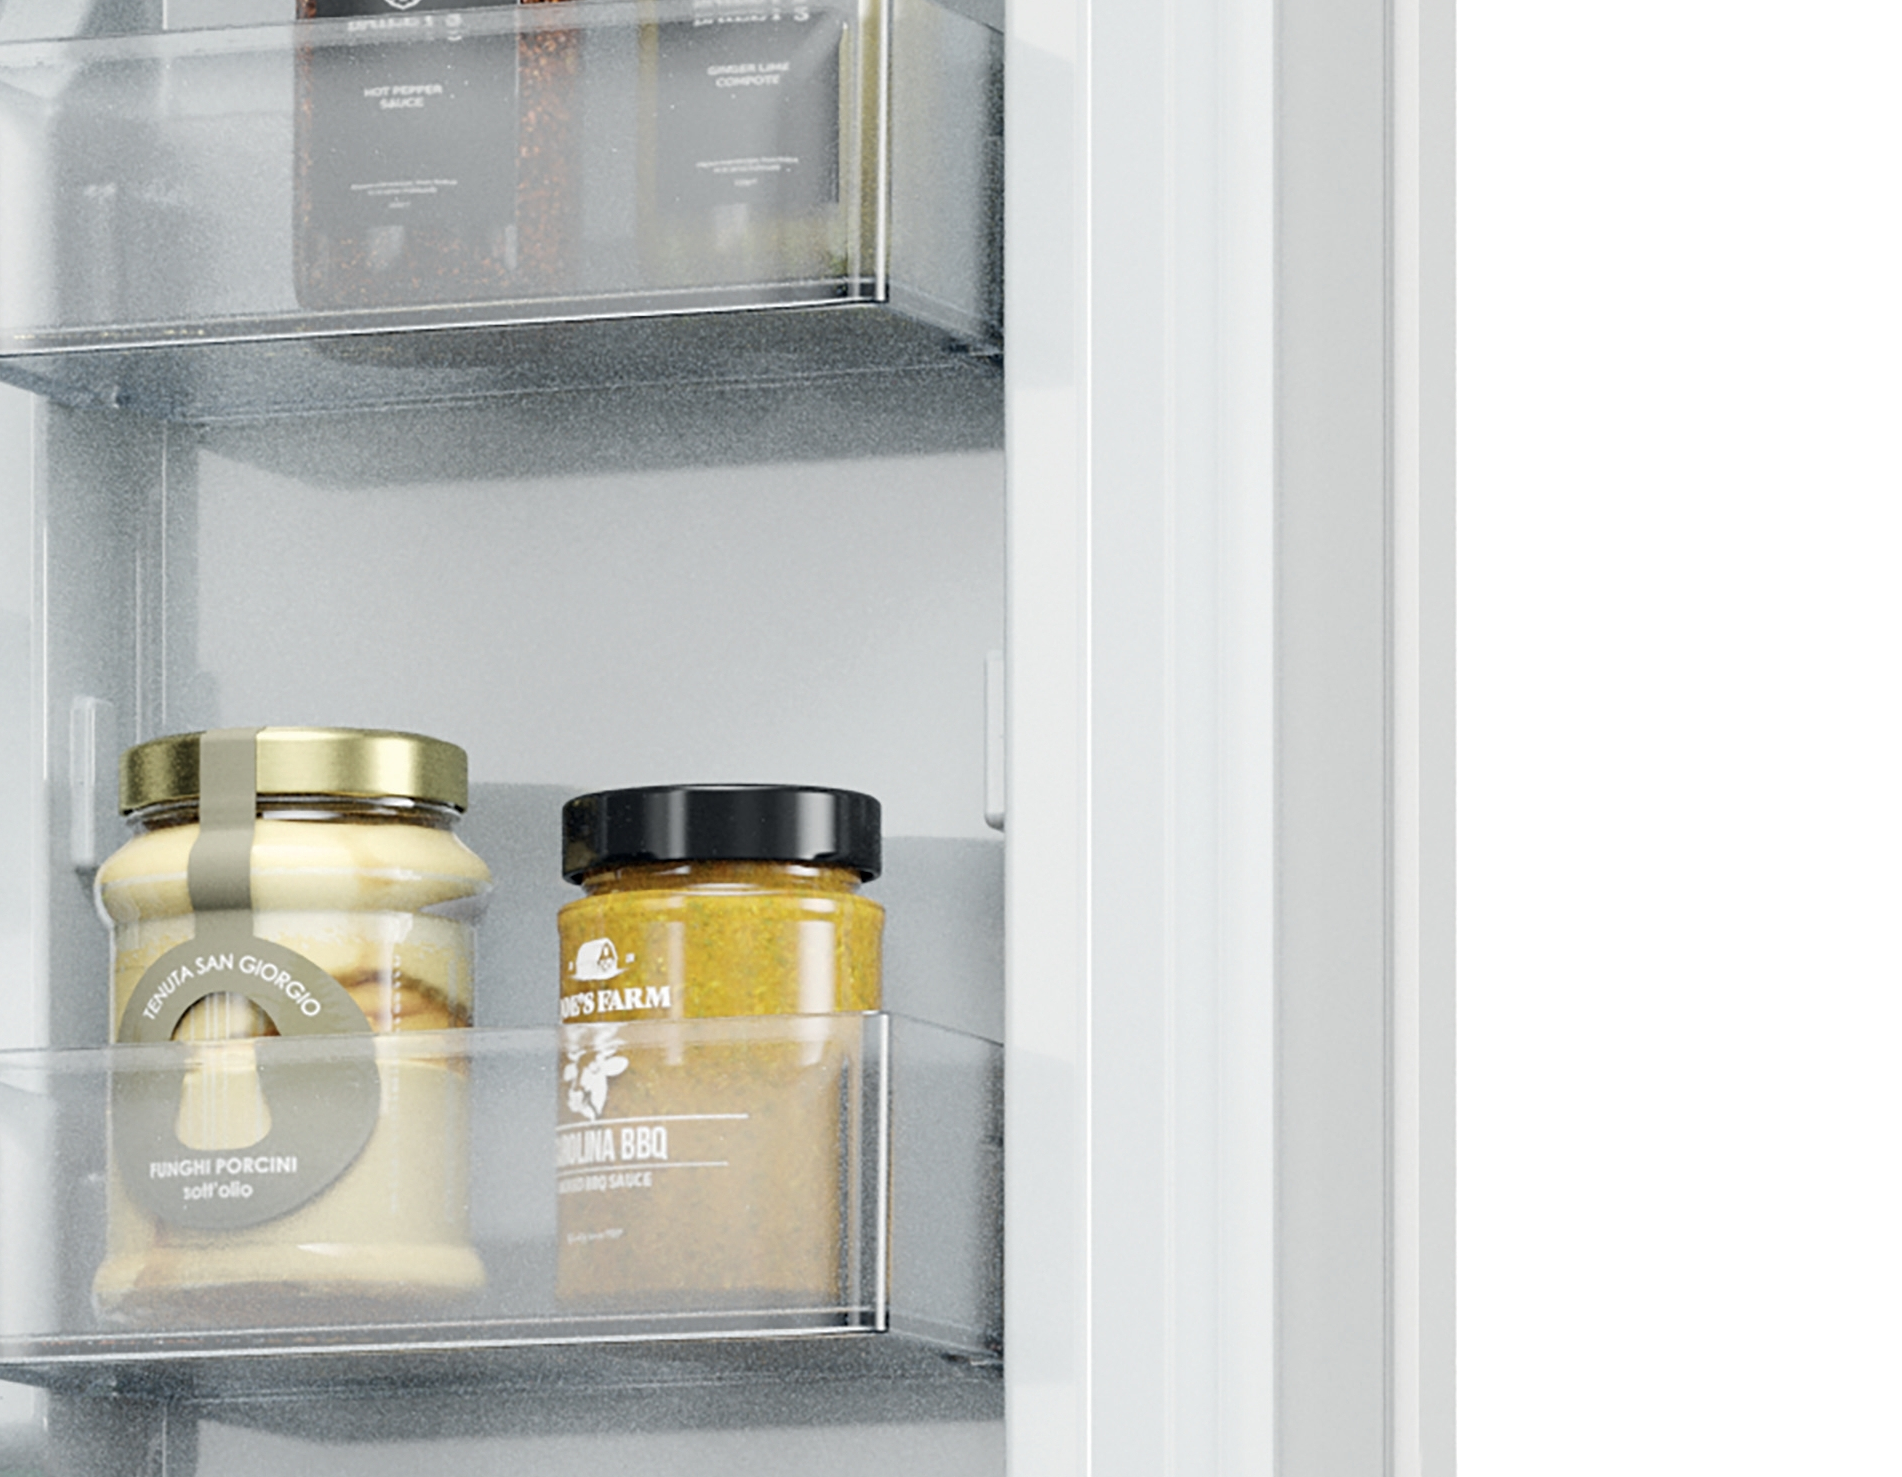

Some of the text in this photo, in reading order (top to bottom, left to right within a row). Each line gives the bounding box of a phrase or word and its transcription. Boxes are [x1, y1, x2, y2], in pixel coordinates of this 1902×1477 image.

[758, 61, 790, 73] LIME
[715, 73, 780, 88] COMPOTE
[364, 83, 443, 98] HOT PEPPER
[380, 97, 424, 110] SAUCE
[142, 952, 322, 1020] TENUTA SAN GIORGIO
[560, 985, 672, 1018] OE'S FARM
[620, 1125, 669, 1161] BBQ
[149, 1156, 299, 1180] FUNGHI PORCINI
[608, 1171, 653, 1189] SAUCE
[183, 1181, 254, 1202] sott'olio
